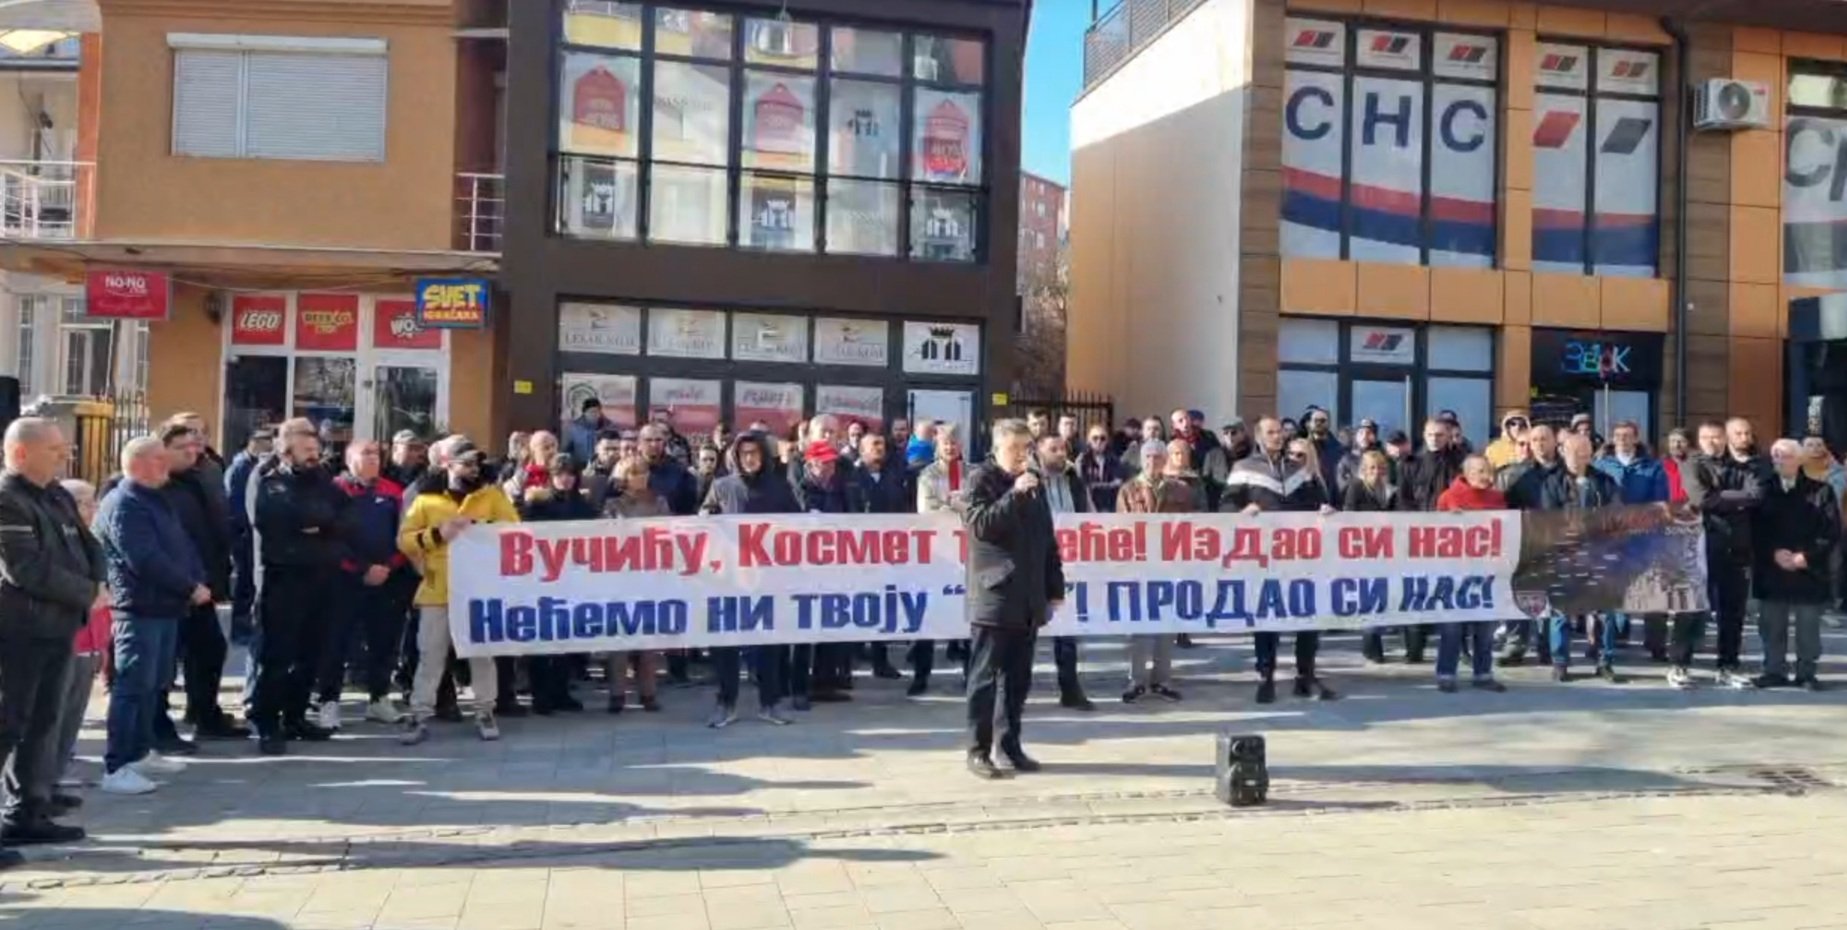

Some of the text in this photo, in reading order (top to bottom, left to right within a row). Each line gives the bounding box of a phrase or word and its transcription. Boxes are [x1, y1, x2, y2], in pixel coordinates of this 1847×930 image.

[422, 284, 481, 308] SVET
[241, 310, 282, 330] LEGO
[500, 532, 722, 581] Вучићу,
[739, 522, 937, 568] Космет
[1163, 522, 1322, 567] Издао
[1338, 527, 1394, 558] си
[1409, 519, 1502, 558] нас!
[469, 597, 689, 644] Нећемо
[707, 596, 775, 633] ни
[791, 584, 928, 634] твоју
[1107, 578, 1317, 628] ПРОДАО
[1331, 578, 1389, 616] СИ
[1400, 575, 1495, 612] НАС!
